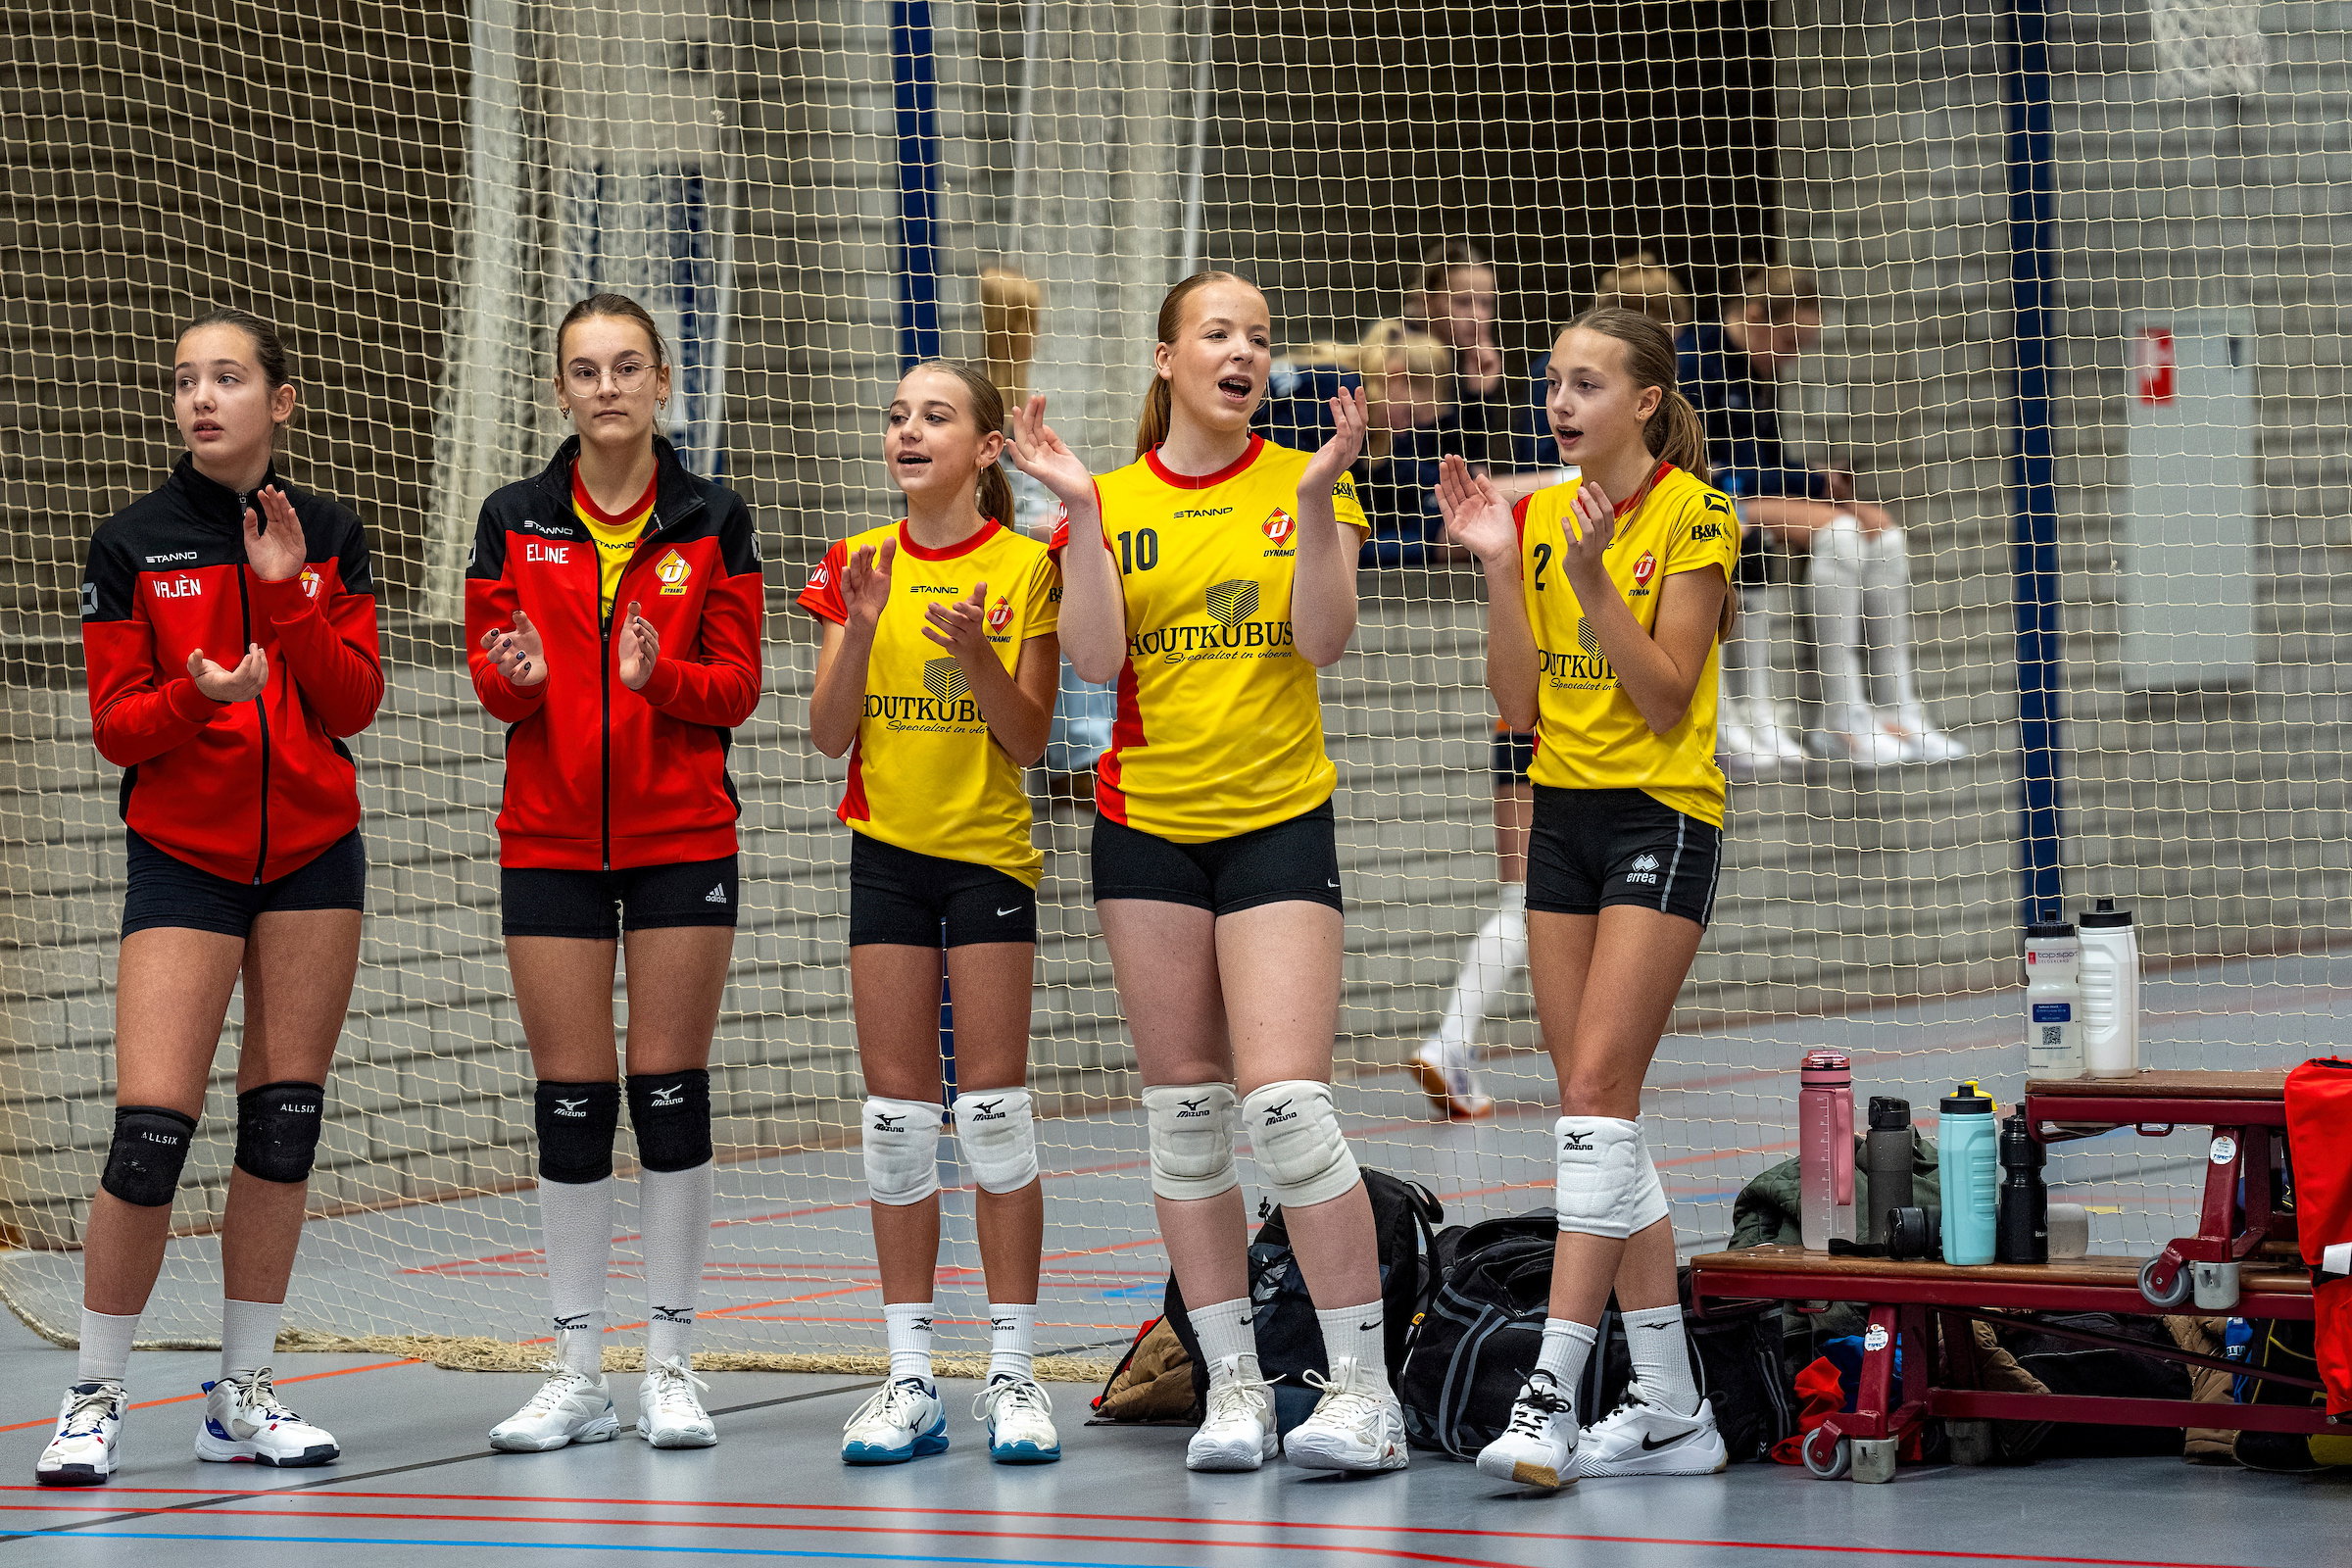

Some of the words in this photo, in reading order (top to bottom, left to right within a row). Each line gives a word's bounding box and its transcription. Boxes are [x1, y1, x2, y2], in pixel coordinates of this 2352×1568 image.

[1173, 507, 1233, 519] STANNO
[523, 519, 573, 536] STANNO
[1691, 522, 1723, 541] B&K
[145, 551, 198, 564] STANNO
[526, 543, 569, 564] ELINE
[1117, 527, 1158, 575] 10
[1263, 549, 1297, 558] DYNAMO
[1533, 543, 1552, 591] 2
[152, 574, 202, 598] VAJÈN
[909, 585, 959, 595] STANNO
[1128, 621, 1294, 658] HOUTKUBUS
[1163, 650, 1238, 665] Specialist
[1549, 677, 1601, 691] Specialist
[886, 720, 952, 733] Specialist
[706, 895, 727, 904] adidas
[279, 1102, 316, 1113] ALLSIX
[140, 1131, 178, 1146] ALLSIX
